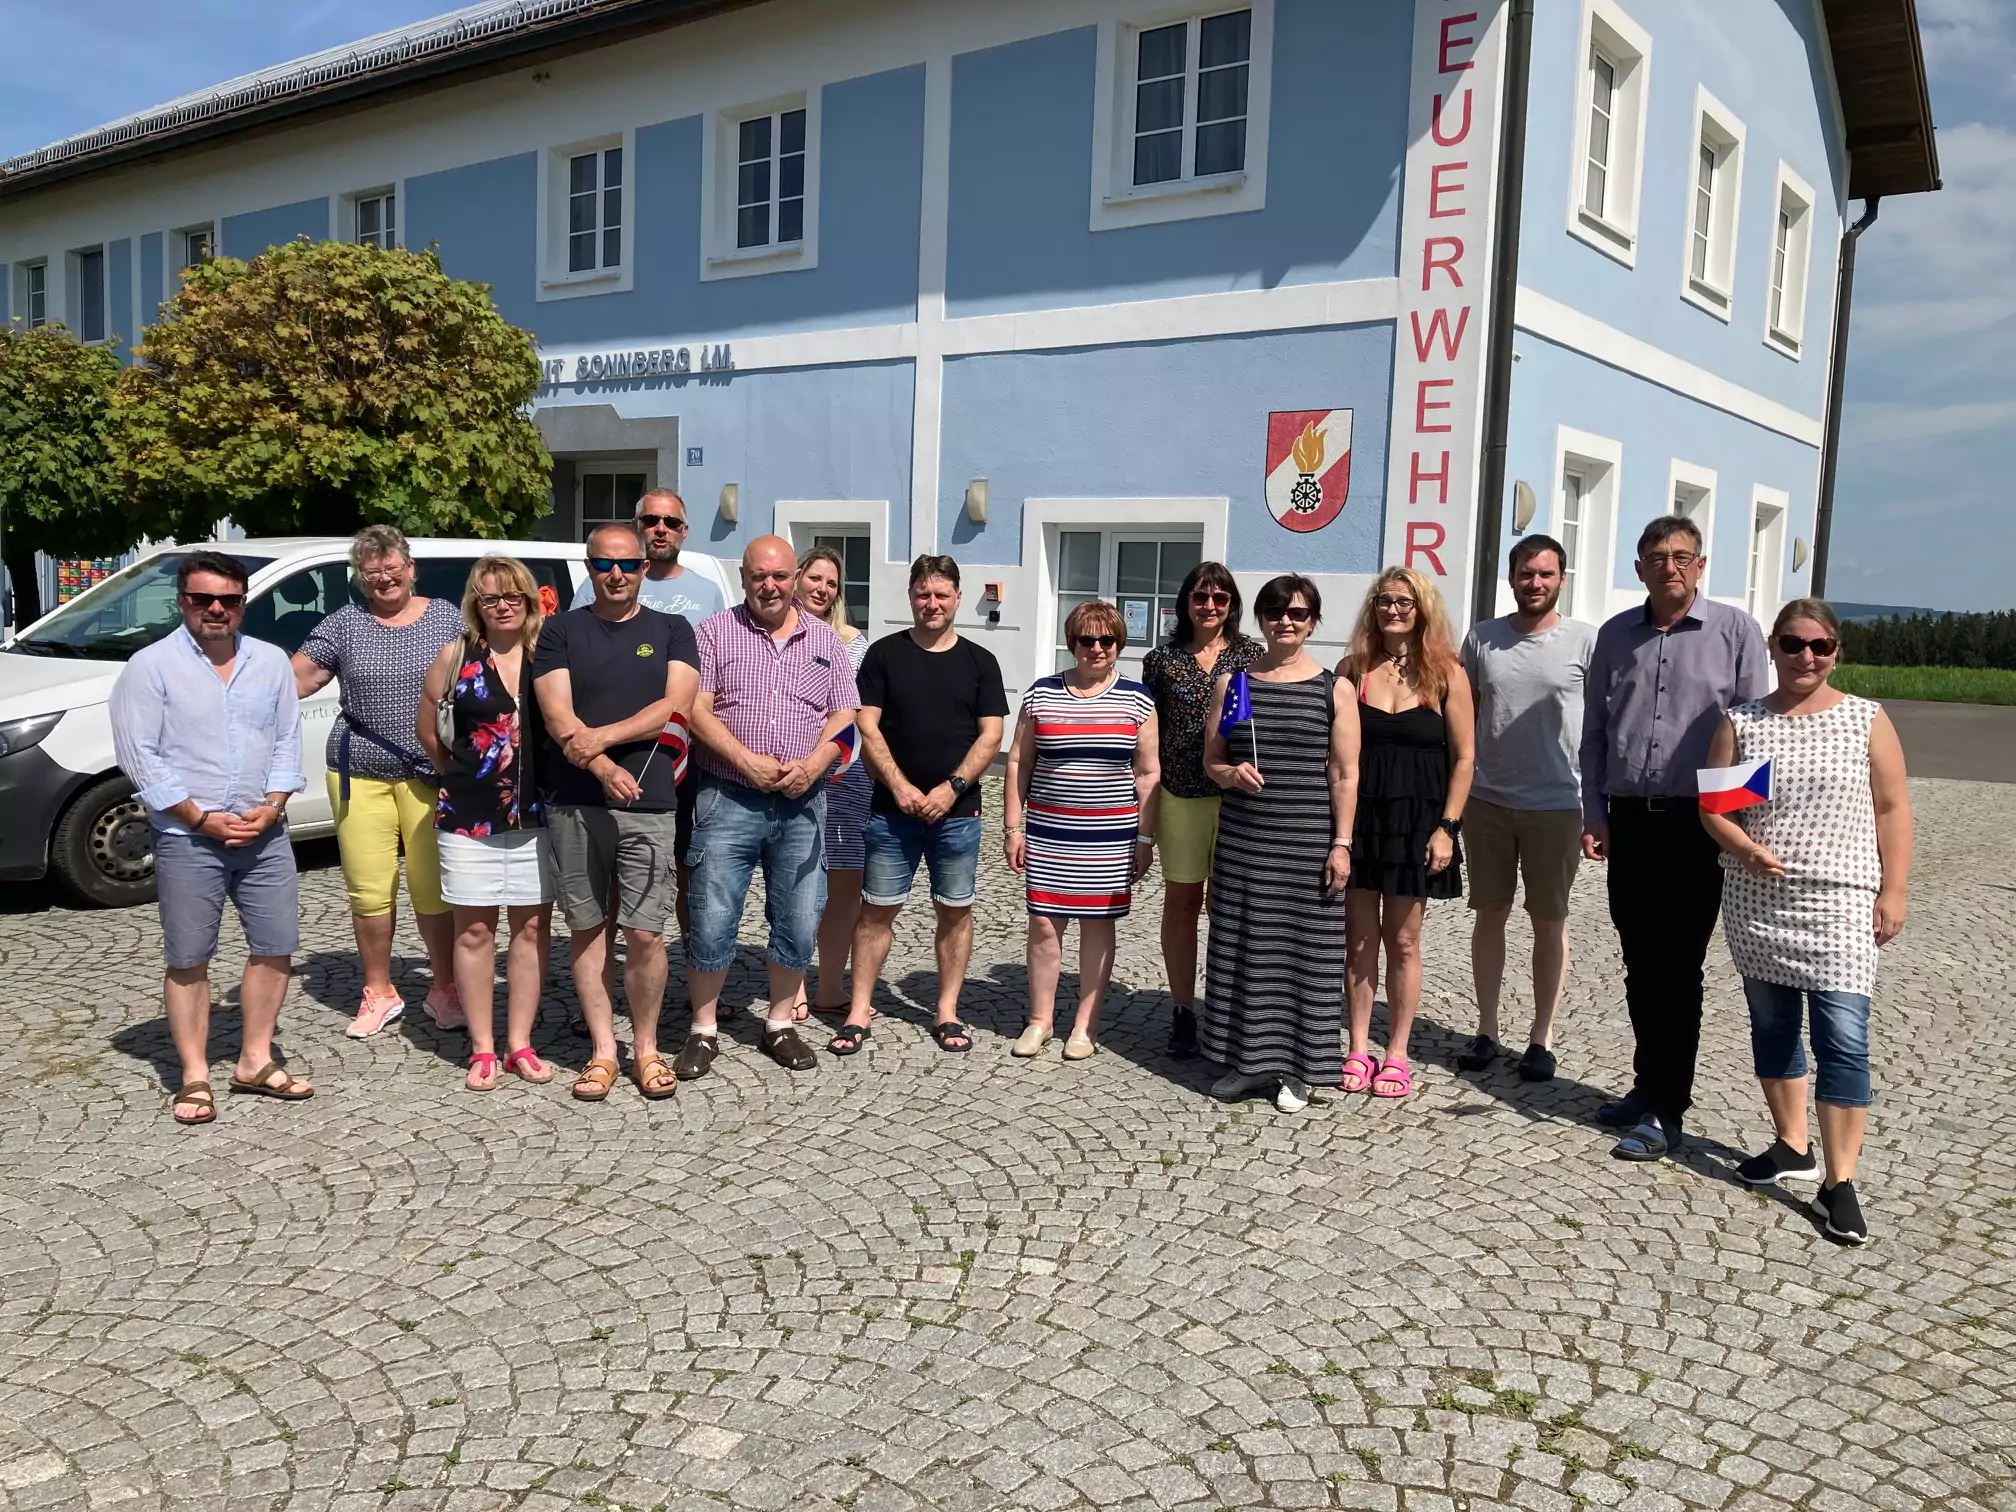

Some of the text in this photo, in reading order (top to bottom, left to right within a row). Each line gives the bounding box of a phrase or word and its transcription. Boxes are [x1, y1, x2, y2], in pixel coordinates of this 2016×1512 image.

[1405, 0, 1478, 576] EUERWEHR
[576, 347, 691, 380] SONNBERG
[664, 594, 701, 614] Blue
